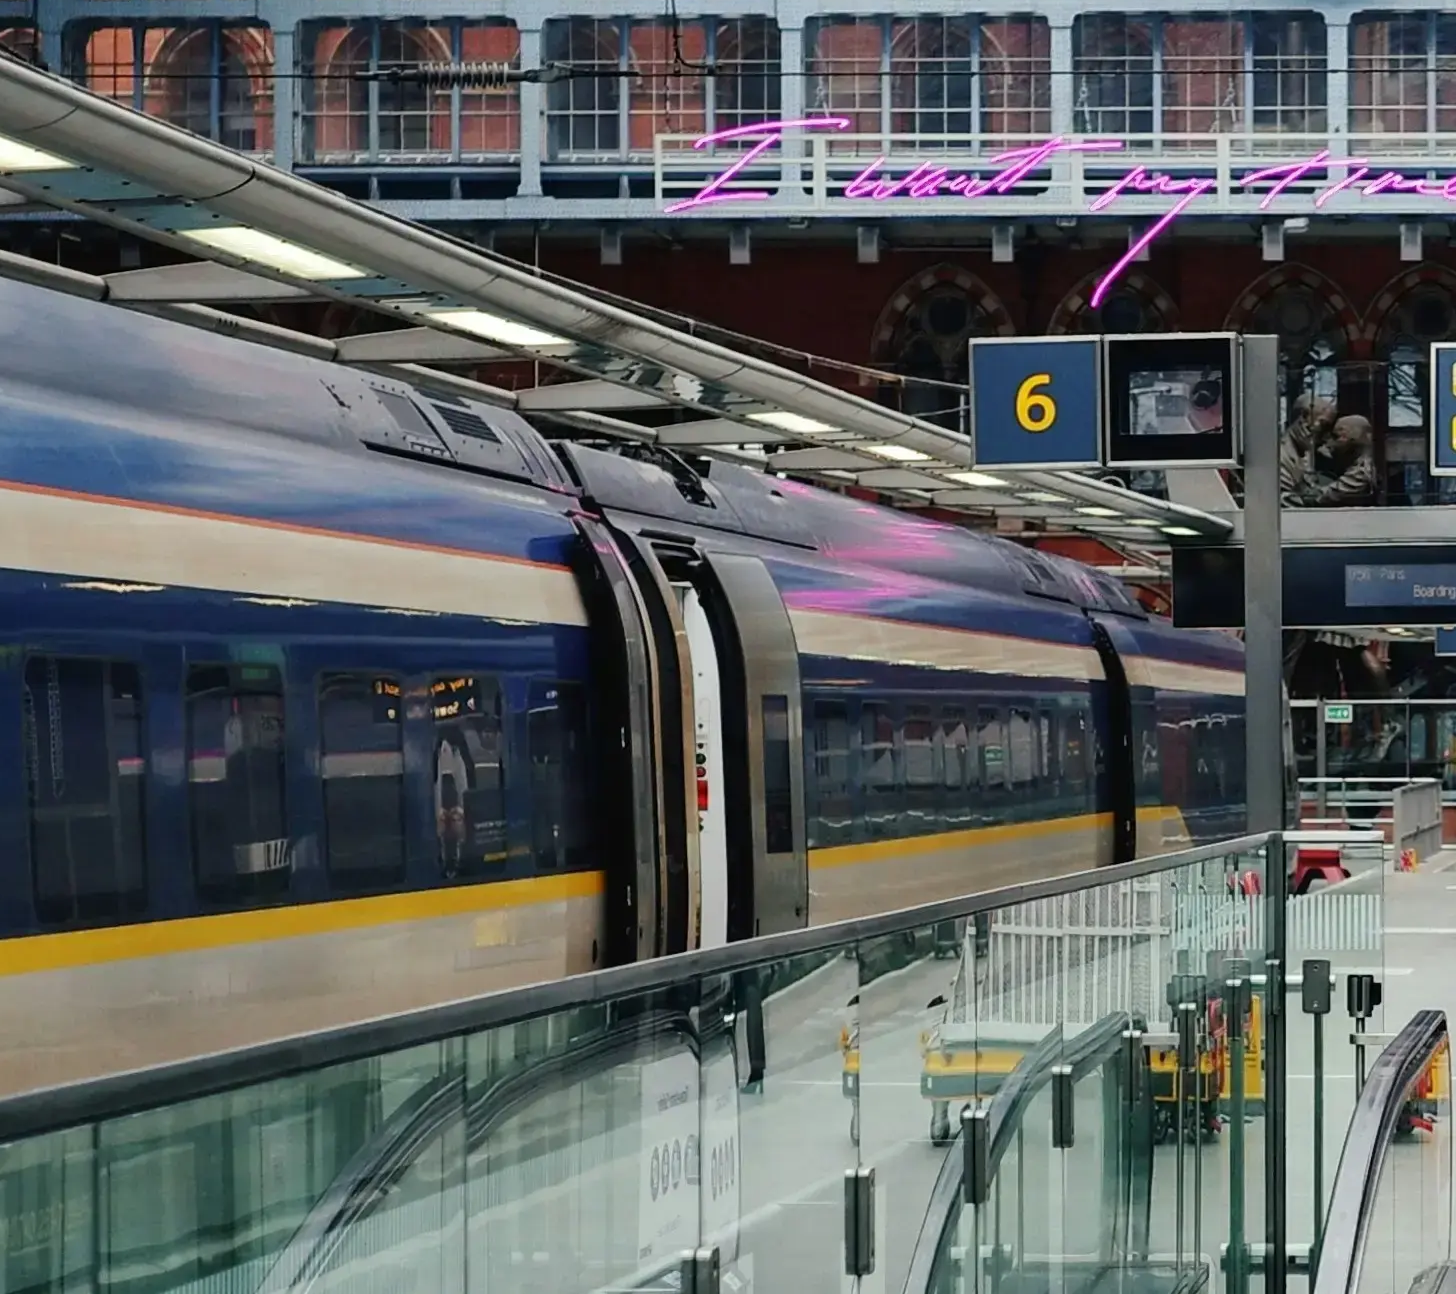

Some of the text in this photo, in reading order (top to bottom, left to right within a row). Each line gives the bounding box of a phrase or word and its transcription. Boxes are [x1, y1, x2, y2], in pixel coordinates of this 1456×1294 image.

[663, 116, 850, 213] I
[1088, 164, 1216, 308] my
[1015, 373, 1057, 433] 6
[1413, 584, 1456, 600] Boarding
